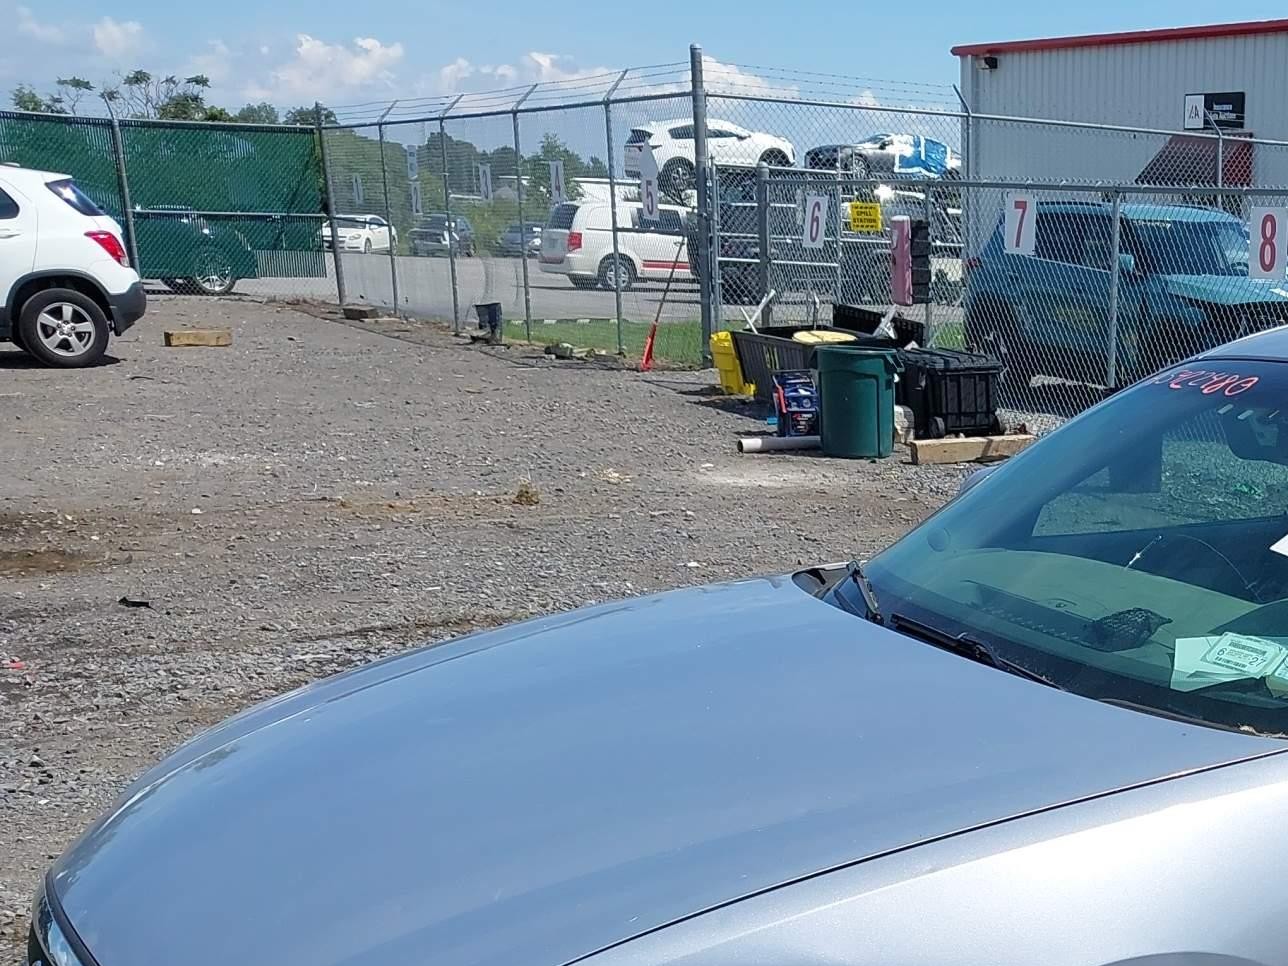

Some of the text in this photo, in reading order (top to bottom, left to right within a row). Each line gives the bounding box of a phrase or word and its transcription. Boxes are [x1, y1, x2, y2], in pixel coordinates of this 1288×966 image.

[645, 179, 654, 216] 5
[809, 201, 821, 243] 6
[1013, 200, 1029, 249] 7
[1258, 213, 1278, 273] 8
